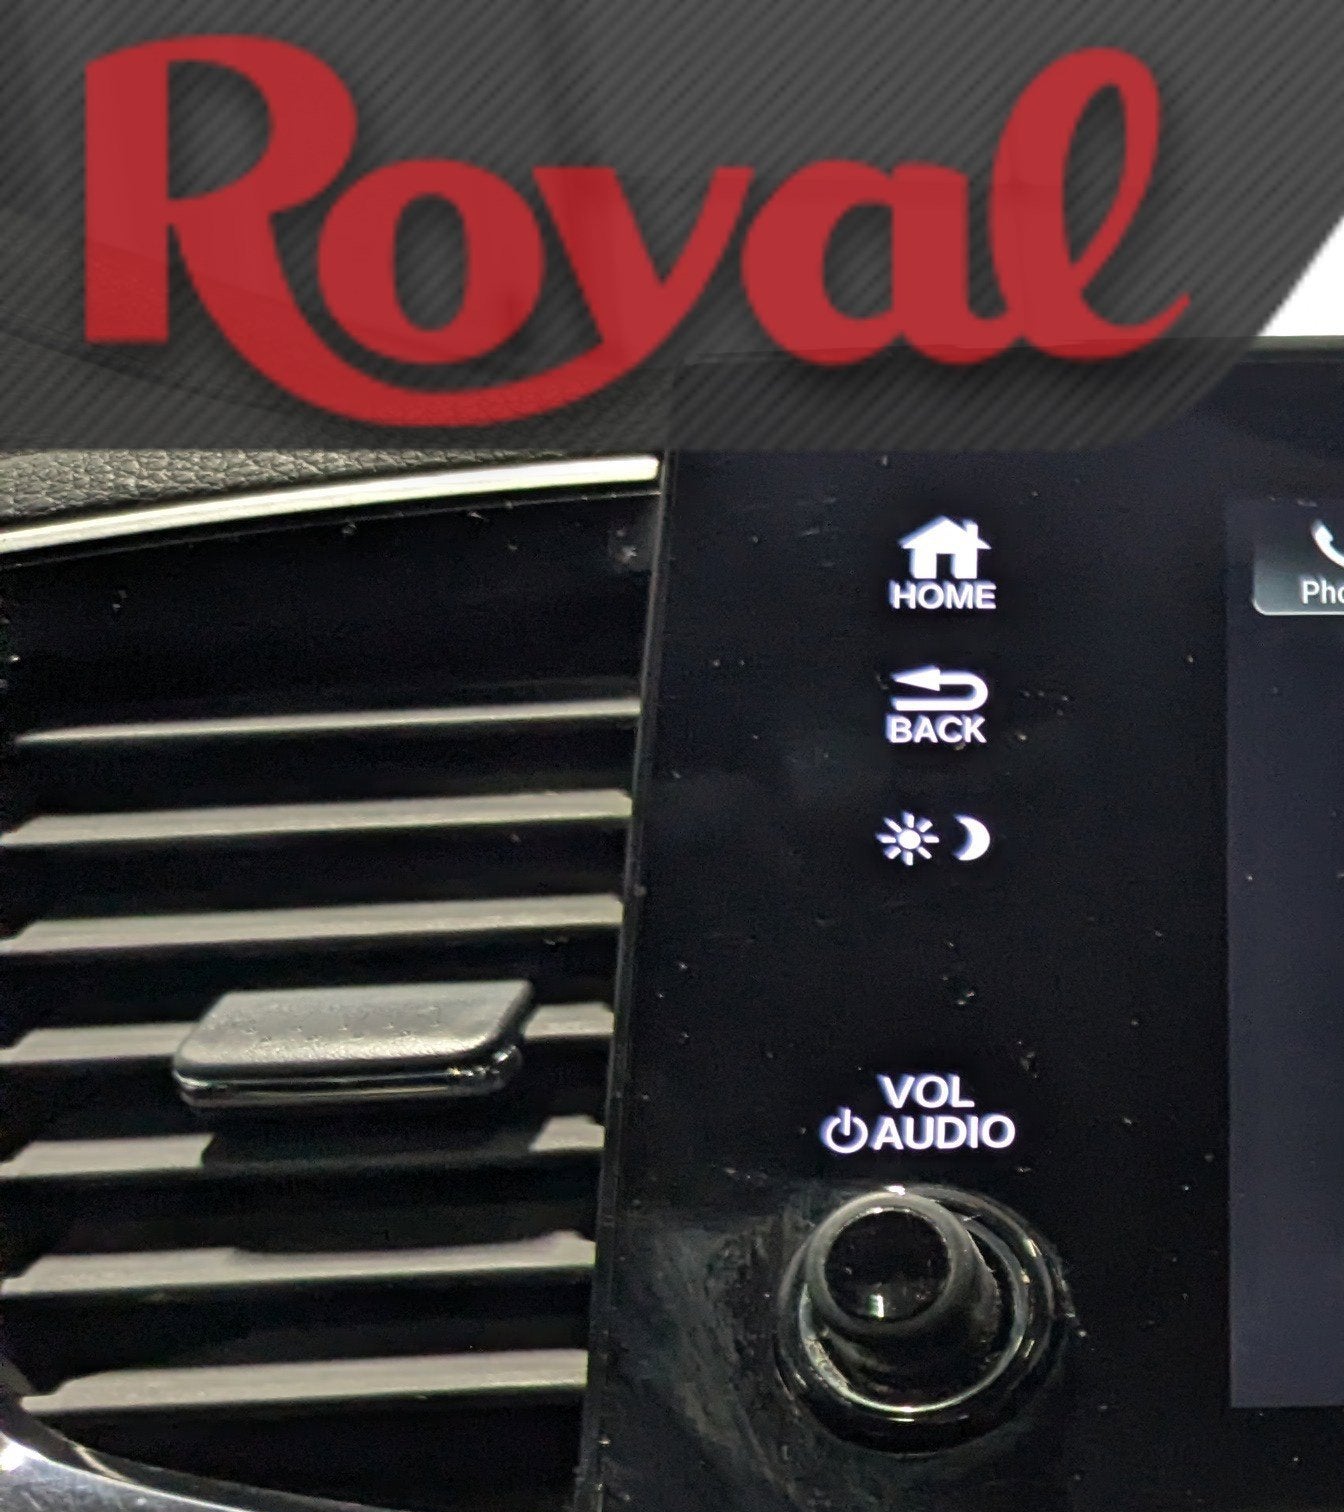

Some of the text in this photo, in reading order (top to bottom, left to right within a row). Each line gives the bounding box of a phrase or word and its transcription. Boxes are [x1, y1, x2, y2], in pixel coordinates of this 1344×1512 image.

[890, 580, 997, 611] HOME
[886, 715, 987, 744] BACK
[877, 1075, 975, 1108] VOL
[873, 1115, 1017, 1150] AUDIO
